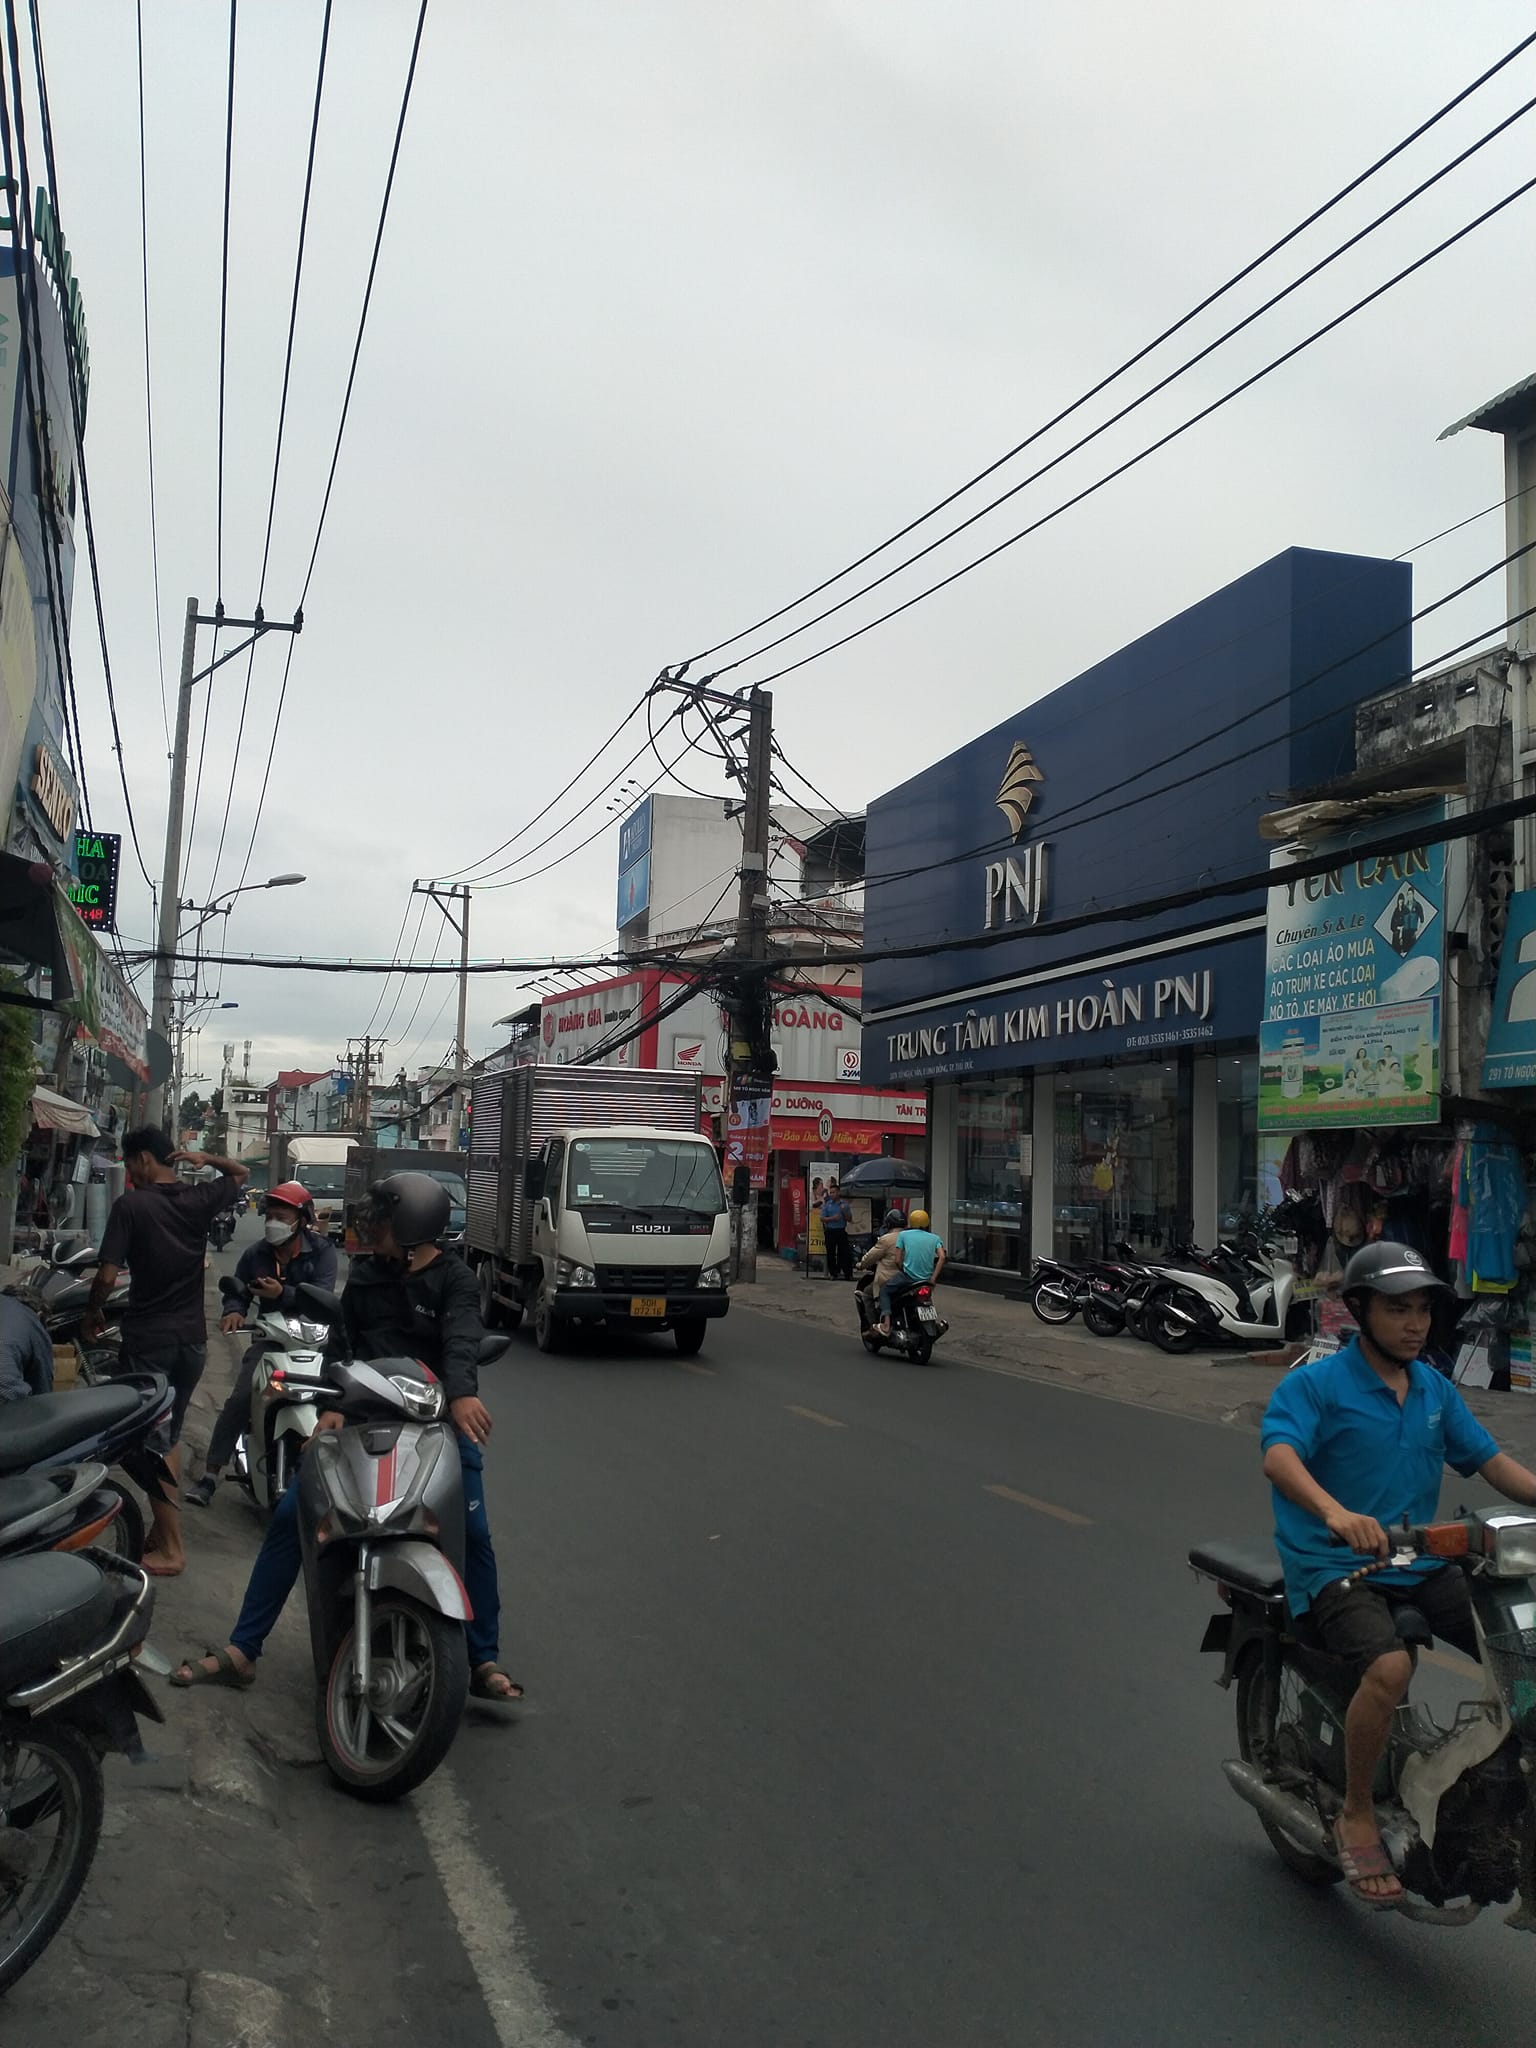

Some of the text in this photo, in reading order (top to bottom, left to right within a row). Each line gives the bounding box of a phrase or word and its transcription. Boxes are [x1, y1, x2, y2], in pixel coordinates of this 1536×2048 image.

[983, 841, 1050, 930] PNJ
[1336, 916, 1346, 931] &
[1271, 937, 1375, 974] CÁC LOẠI ÁO MƯA
[1270, 963, 1376, 997] ÁO TRÙM XE CÁC LOẠI
[887, 970, 1216, 1063] TRUNG TÂM KIM HOÀN PNJ
[1269, 1002, 1284, 1020] MÔ
[1302, 1000, 1316, 1016] XE
[1342, 991, 1356, 1007] XE
[558, 1010, 585, 1033] HOÀNG
[587, 1008, 602, 1027] GIA
[842, 1069, 861, 1078] SYM
[1488, 1067, 1502, 1081] 291
[1504, 1063, 1514, 1080] TÔ
[786, 1096, 823, 1111] DƯỠNG
[631, 1224, 671, 1234] ISUZU
